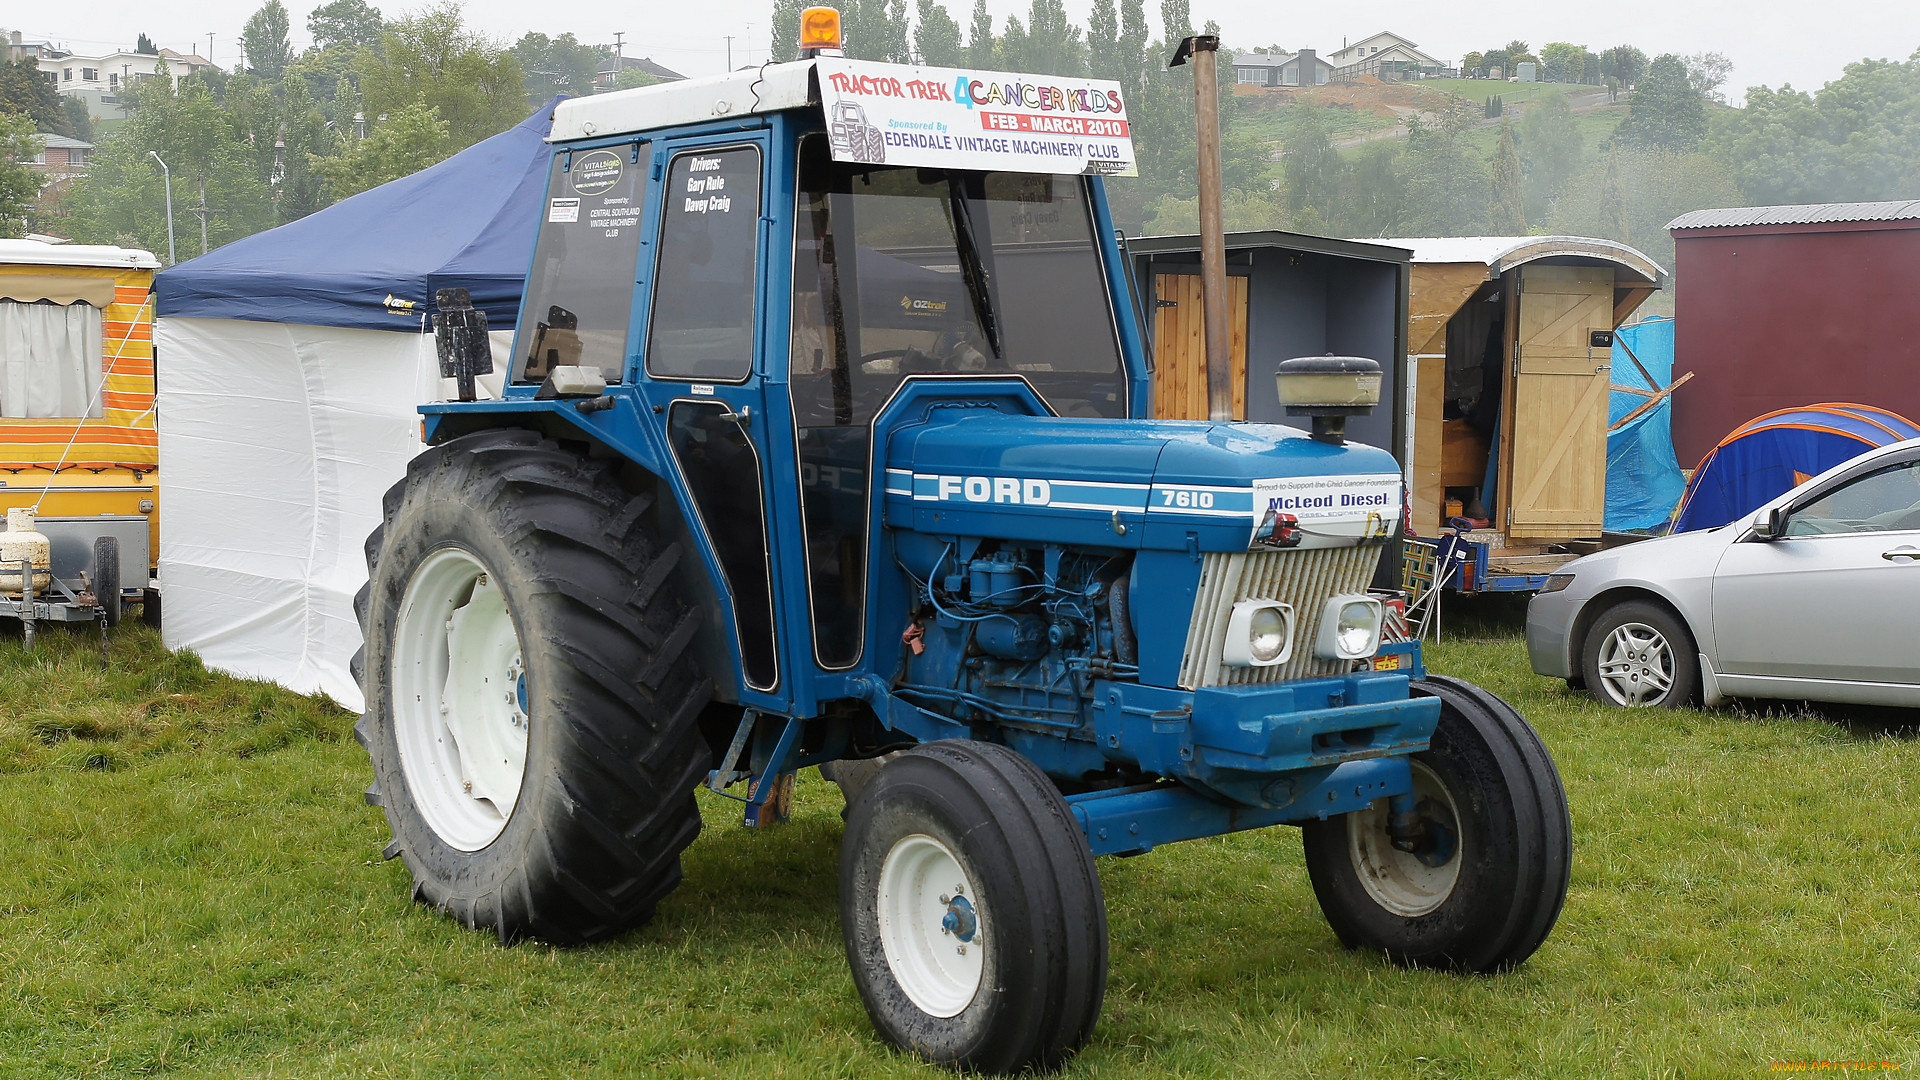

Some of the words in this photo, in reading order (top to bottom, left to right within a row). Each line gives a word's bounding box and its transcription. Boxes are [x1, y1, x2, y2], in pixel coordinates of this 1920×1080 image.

[829, 72, 905, 98] TRACTOR
[906, 79, 952, 101] TREK
[888, 119, 934, 130] Sponsored
[936, 122, 948, 133] By
[988, 114, 1019, 130] FEB
[1030, 117, 1084, 134] MARCH
[1086, 120, 1122, 136] 2010
[885, 132, 952, 150] EDENDALE
[954, 136, 1010, 153] VINTAGE
[1012, 140, 1083, 157] MACHINERY
[1088, 144, 1120, 159] CLUB
[689, 156, 722, 172] Drivers:
[687, 177, 706, 194] Gary
[706, 175, 725, 190] Rule
[590, 209, 611, 217] CENTRAL
[611, 207, 640, 216] SOUTHLAND
[684, 197, 709, 214] Davey
[709, 195, 731, 213] Craig
[590, 219, 610, 227] VINTAGE
[610, 218, 638, 227] MACHINERY
[913, 299, 947, 309] OZtrail
[939, 476, 1051, 506] FORD
[1287, 481, 1314, 490] Support
[1343, 480, 1366, 488] Cancer
[1161, 490, 1214, 509] 7610
[1269, 494, 1333, 510] McLeod
[1341, 492, 1387, 506] Diesel
